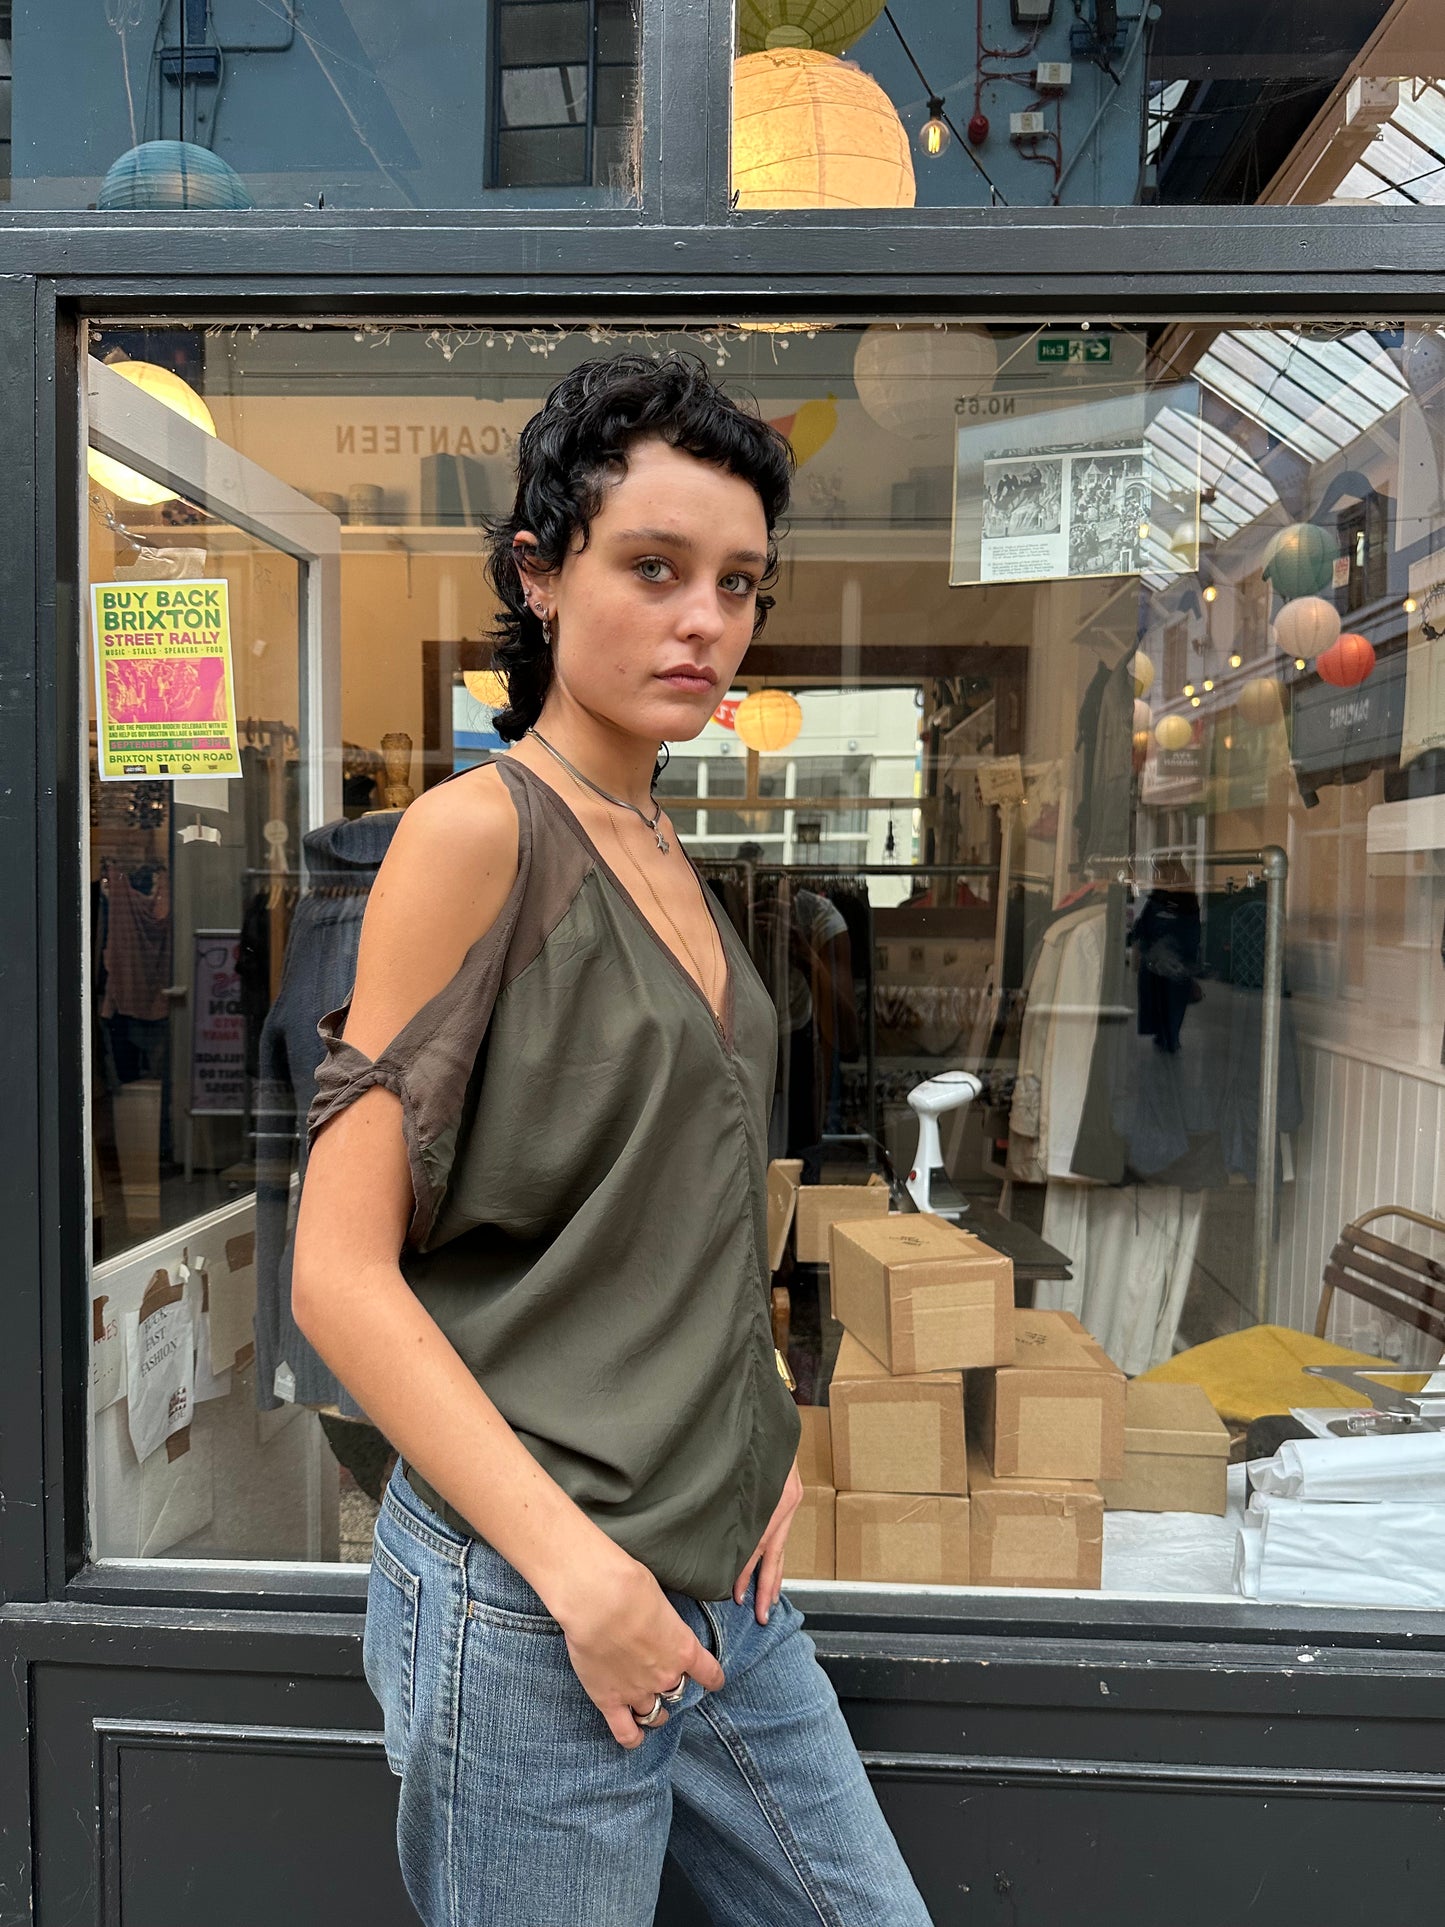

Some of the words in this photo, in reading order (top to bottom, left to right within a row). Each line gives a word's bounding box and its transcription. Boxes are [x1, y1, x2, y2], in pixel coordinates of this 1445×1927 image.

[103, 592, 149, 610] BUY
[156, 590, 219, 608] BACK
[104, 609, 221, 631] BRIXTON
[104, 633, 164, 648] STREET
[169, 632, 220, 645] RALLY
[105, 648, 125, 656] MUSIC
[132, 647, 157, 655] STALLS
[164, 646, 198, 654] SPEAKERS
[206, 645, 224, 653] FOOD
[111, 740, 169, 749] SEPTEMBER
[109, 754, 153, 763] BRIXTON
[156, 753, 200, 762] STATION
[203, 752, 233, 761] ROAD
[145, 1325, 167, 1352] FAST
[141, 1336, 179, 1378] FASHION
